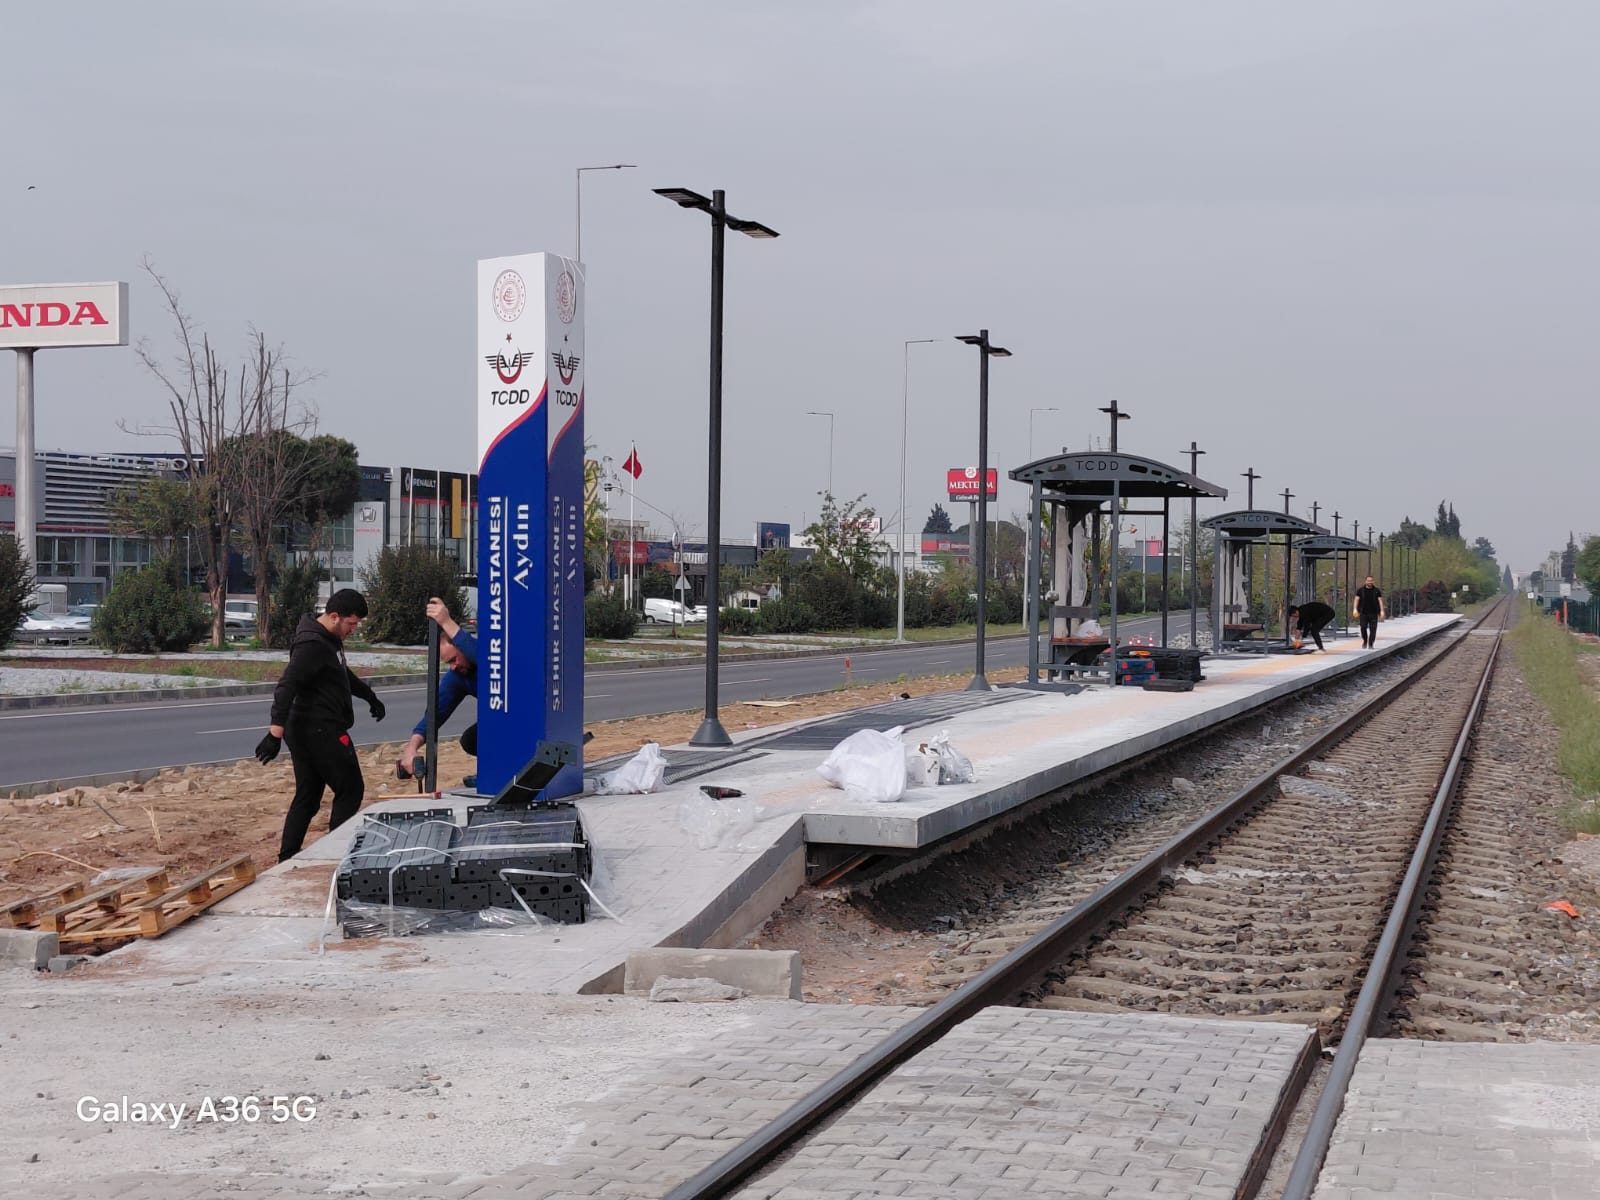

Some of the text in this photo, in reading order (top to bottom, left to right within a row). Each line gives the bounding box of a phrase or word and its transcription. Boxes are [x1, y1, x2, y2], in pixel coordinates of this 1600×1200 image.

[490, 389, 530, 406] TCDD
[555, 389, 578, 407] TCDD
[1074, 460, 1119, 471] TCDD
[412, 478, 437, 489] RENAULT
[949, 480, 994, 489] MEKTEM
[1240, 514, 1270, 522] TCDD
[512, 503, 534, 591] Aydın
[487, 495, 504, 711] ŞEHİR HASTANESİ
